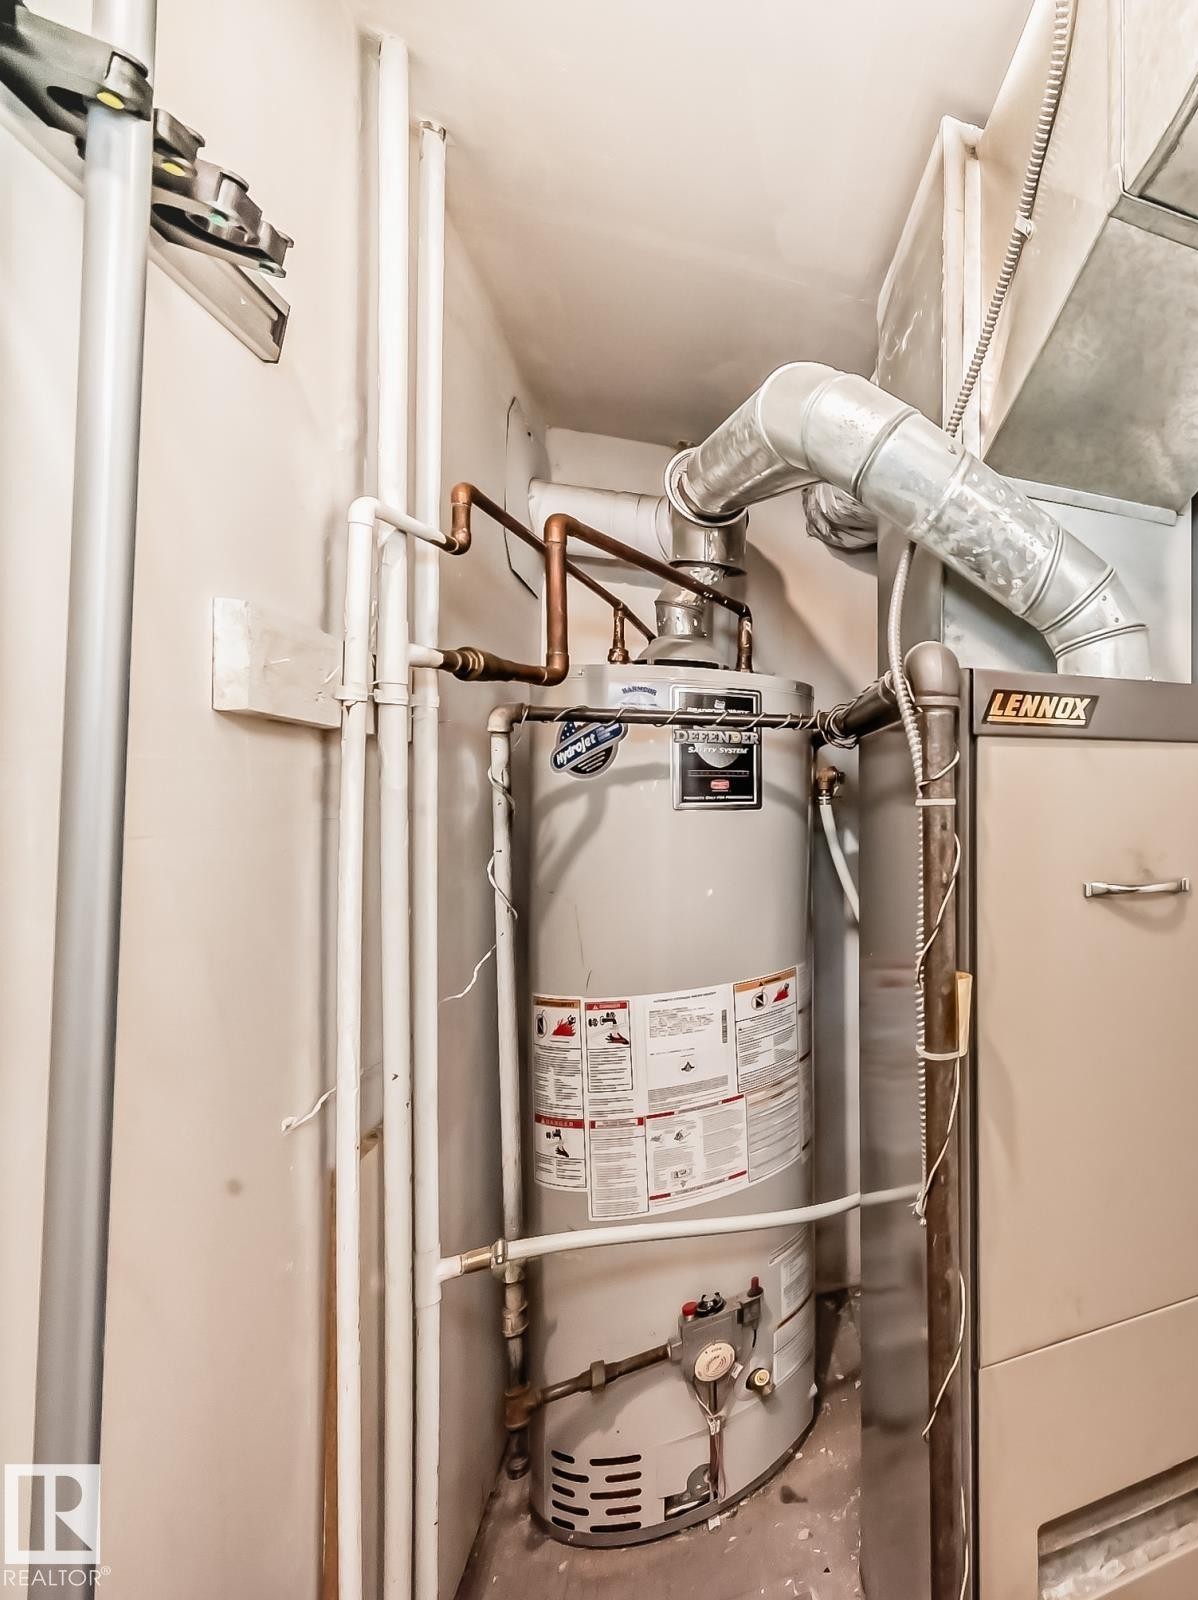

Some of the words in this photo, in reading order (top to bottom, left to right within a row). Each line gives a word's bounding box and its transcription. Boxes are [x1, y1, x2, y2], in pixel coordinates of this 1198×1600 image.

[989, 692, 1091, 719] LENNOX
[674, 729, 759, 745] DEFENDER
[719, 747, 749, 755] SYSTEM
